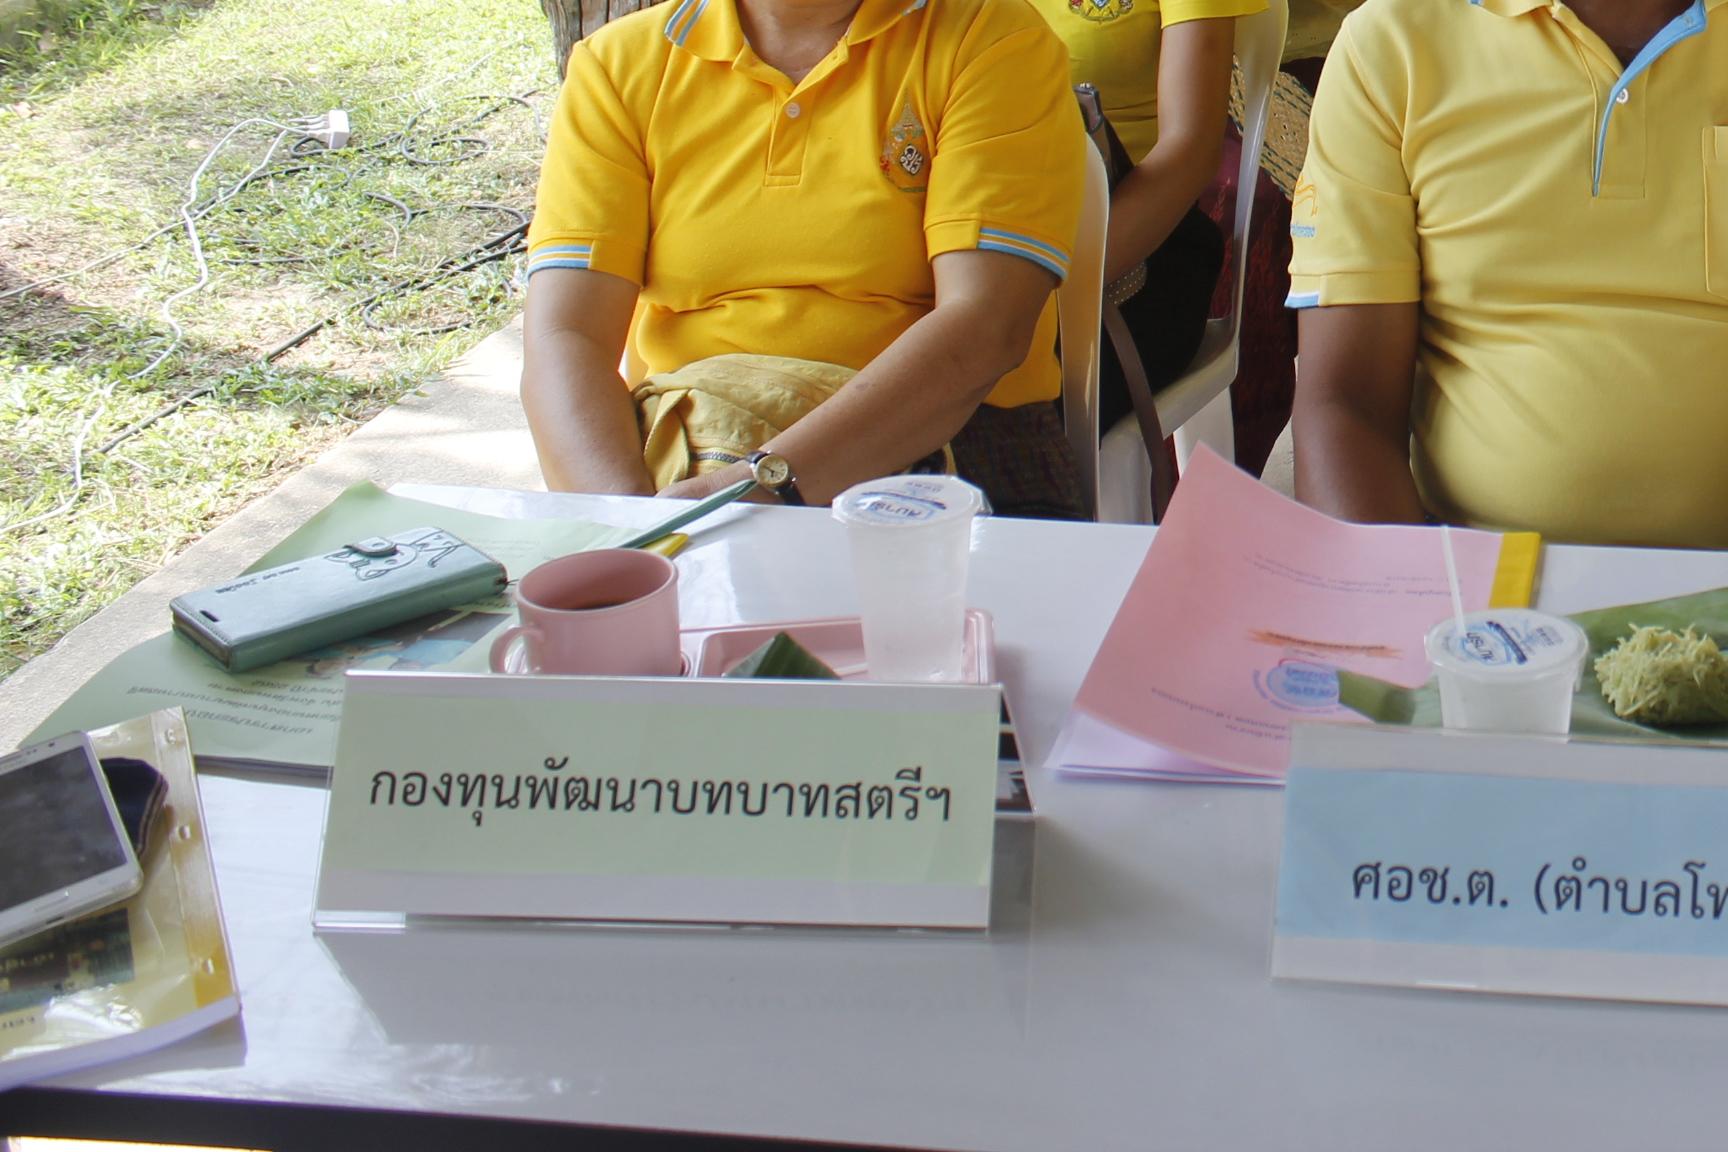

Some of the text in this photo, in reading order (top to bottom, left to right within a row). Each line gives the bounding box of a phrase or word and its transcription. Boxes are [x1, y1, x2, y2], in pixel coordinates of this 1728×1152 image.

[368, 755, 953, 826] กองทุนพัฒนาบทบาทสตรีฯ
[1351, 859, 1509, 909] ศอช.ต.
